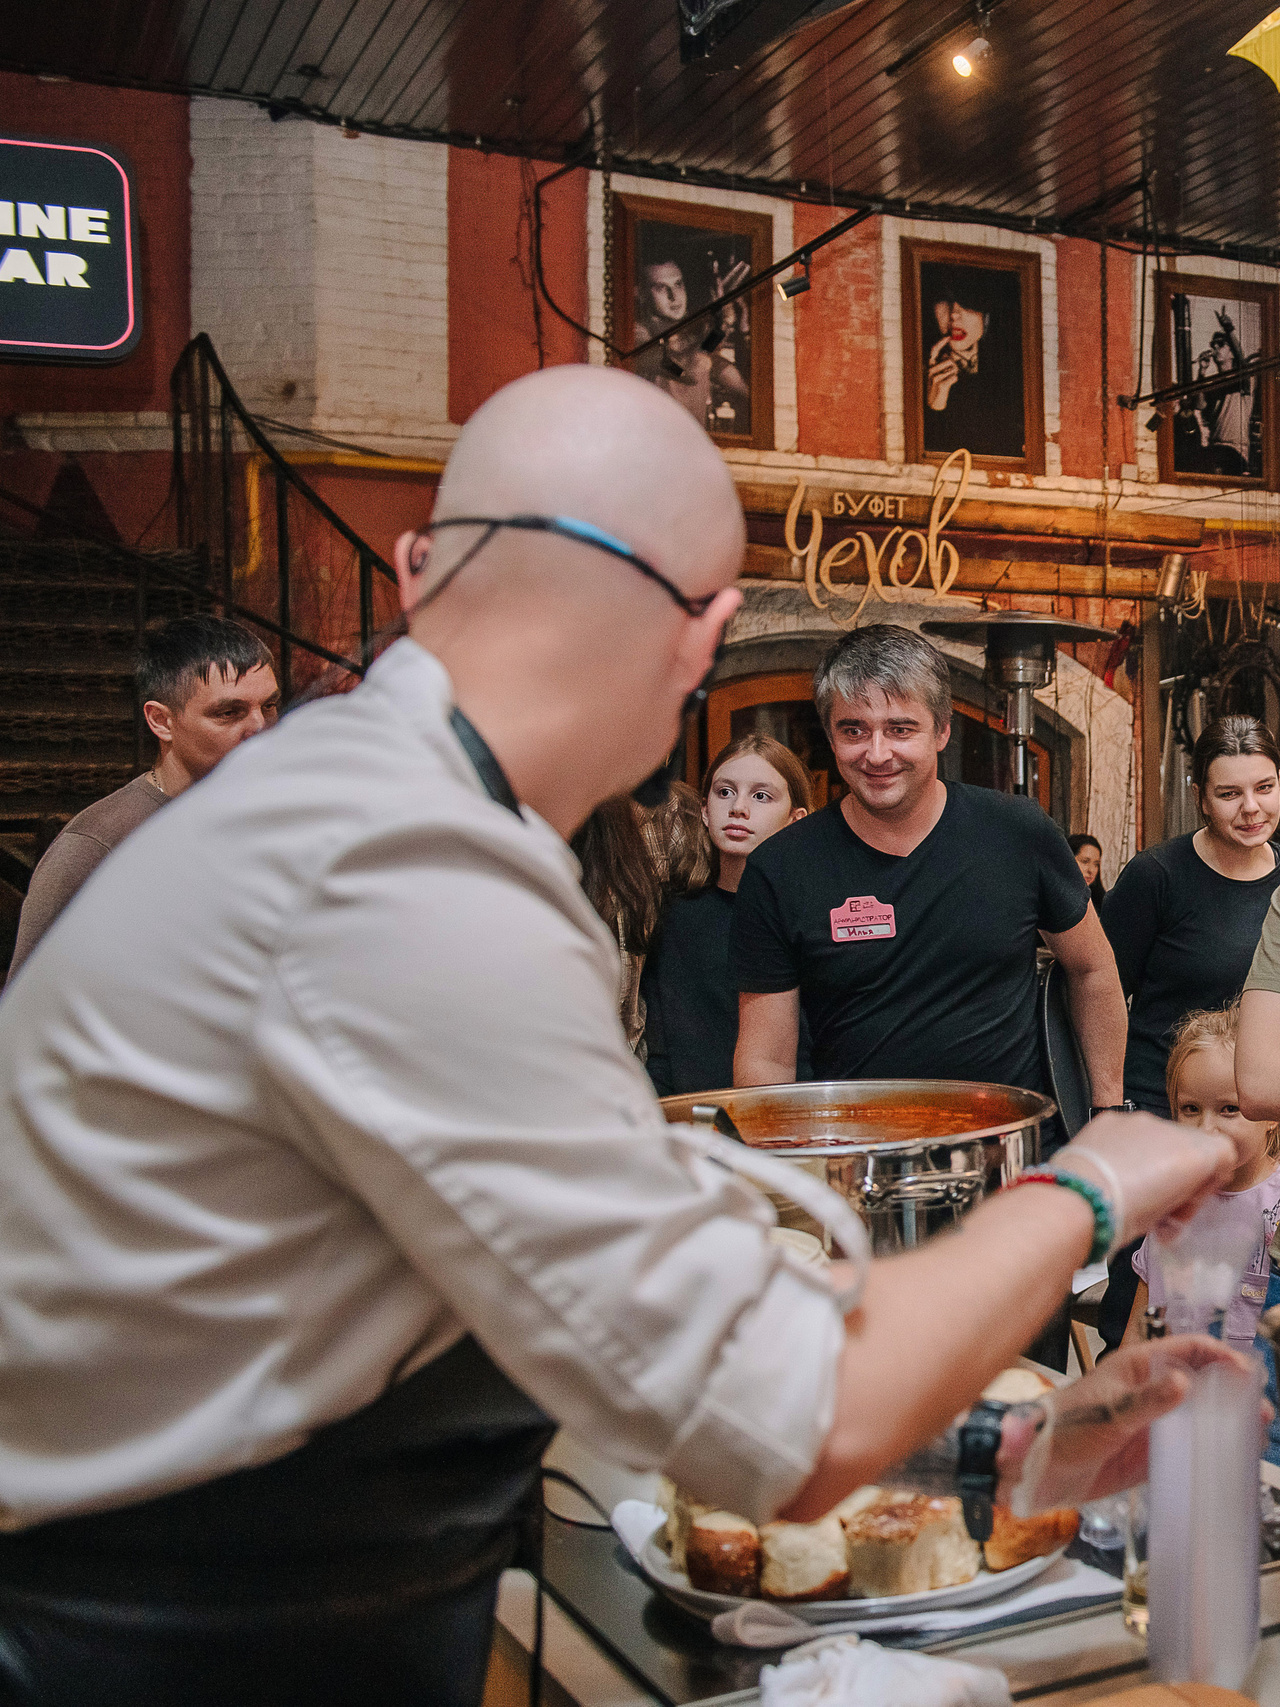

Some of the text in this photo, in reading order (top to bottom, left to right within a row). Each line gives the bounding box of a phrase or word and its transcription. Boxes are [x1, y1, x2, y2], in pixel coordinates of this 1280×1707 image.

[0, 200, 110, 244] INE
[0, 247, 91, 288] AR
[833, 491, 907, 519] БУФЕТ
[785, 448, 1001, 626] Чехов
